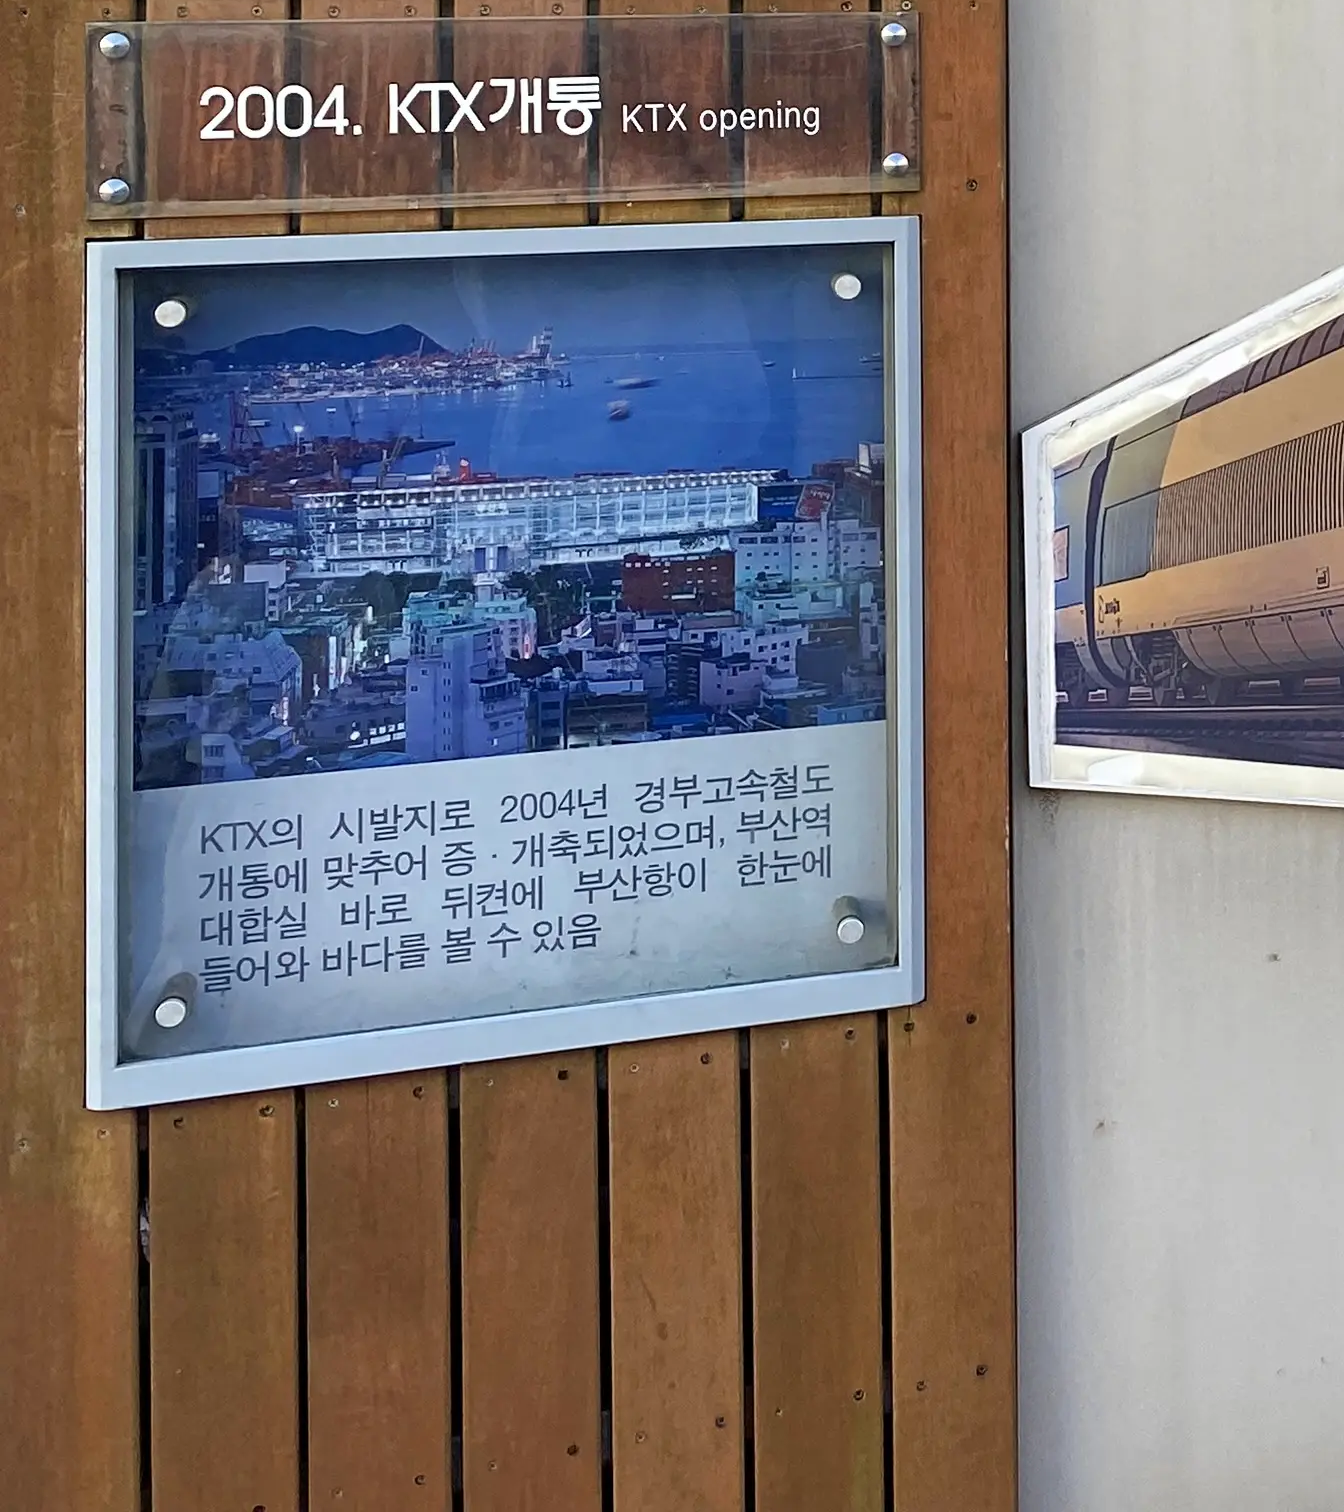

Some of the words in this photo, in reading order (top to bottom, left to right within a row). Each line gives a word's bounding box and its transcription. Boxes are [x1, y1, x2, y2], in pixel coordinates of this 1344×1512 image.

[197, 82, 365, 142] 2004.
[388, 75, 602, 137] KTX개통
[621, 101, 689, 135] KTX
[699, 98, 822, 137] opening
[198, 813, 305, 858] KTX의
[329, 798, 477, 846] 시발지로
[498, 782, 611, 826] 2004년
[631, 761, 836, 818] 경부고속철도
[198, 854, 310, 903] 개통에
[321, 842, 430, 890] 맞추어
[440, 838, 478, 879] 증
[510, 820, 728, 872] 개축되었으며,
[734, 801, 834, 847] 부산역
[198, 896, 310, 948] 대합실
[339, 891, 410, 934] 바로
[440, 873, 546, 922] 뒤켠에
[571, 854, 709, 907] 부산항이
[734, 844, 834, 892] 한눈에
[198, 945, 311, 996] 들어와
[321, 932, 431, 976] 바다를
[442, 926, 478, 967] 볼
[485, 922, 521, 963] 수
[531, 914, 602, 955] 있음
